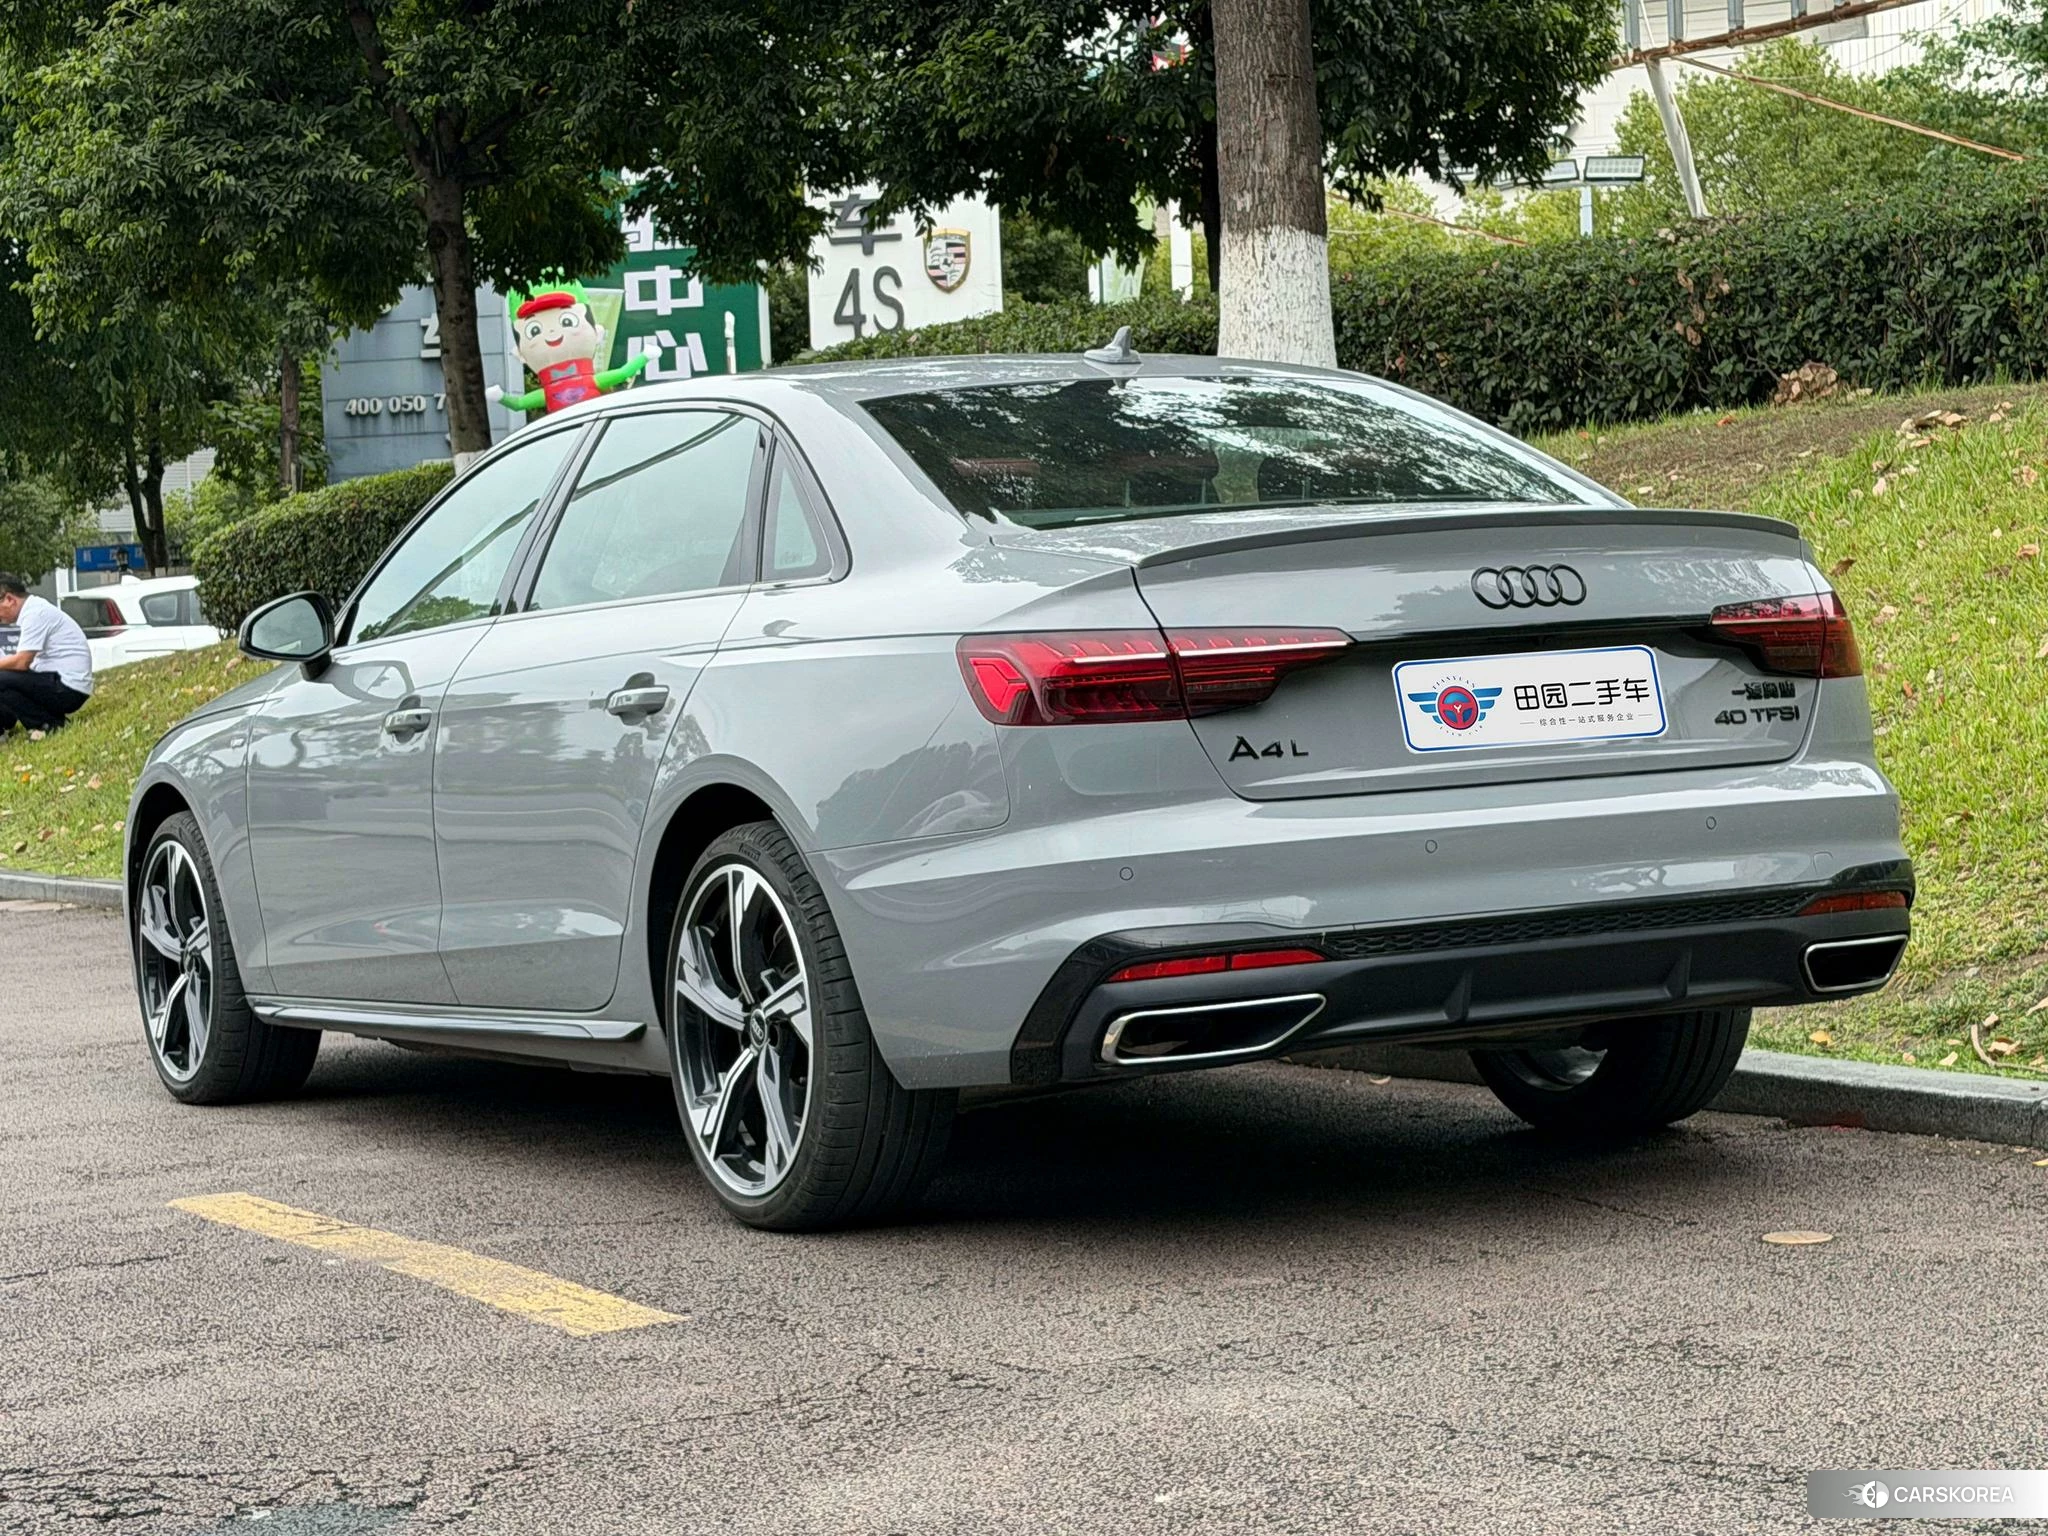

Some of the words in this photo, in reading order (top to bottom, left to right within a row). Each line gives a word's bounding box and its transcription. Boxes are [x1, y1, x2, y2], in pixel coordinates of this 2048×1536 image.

[833, 265, 905, 339] 4S
[345, 398, 382, 415] 400
[388, 395, 426, 413] 050
[1514, 678, 1650, 711] 田园二手车
[1539, 713, 1634, 727] 综合性一站式服务企业
[1714, 709, 1747, 725] 40
[1750, 705, 1800, 723] TFSI
